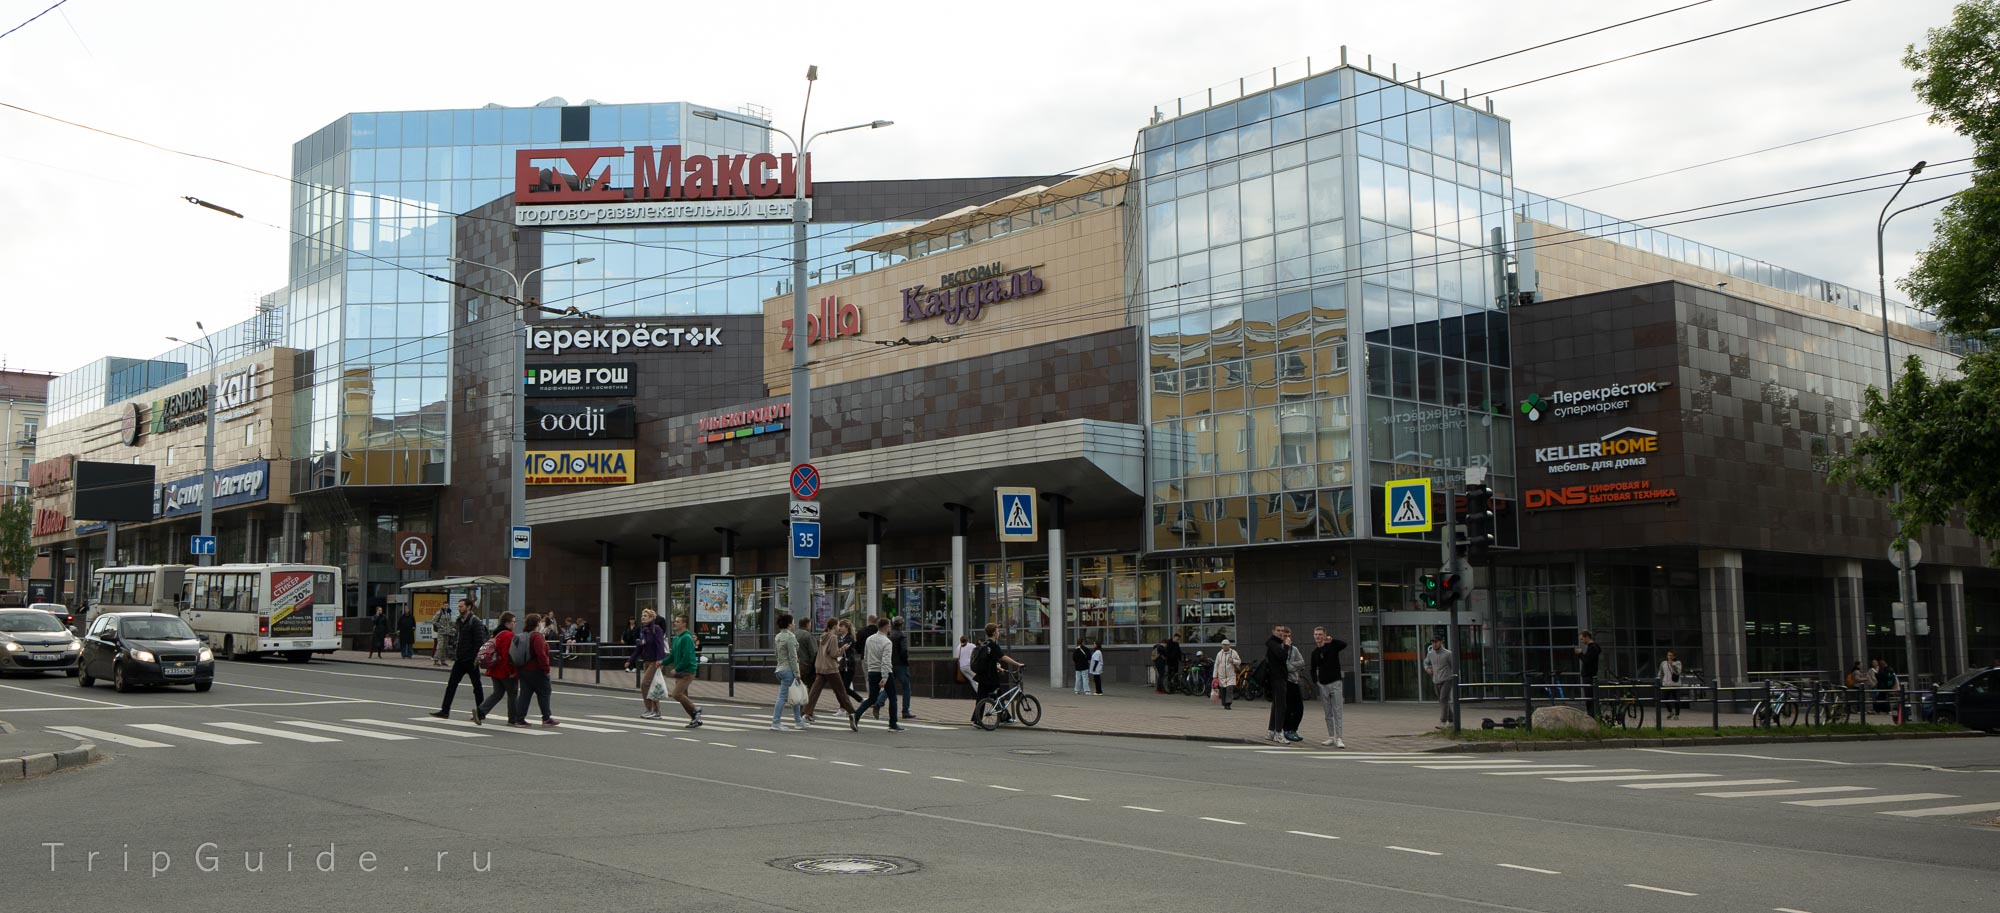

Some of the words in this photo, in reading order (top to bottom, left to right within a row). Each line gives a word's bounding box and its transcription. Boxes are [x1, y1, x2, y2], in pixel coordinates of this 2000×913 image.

[634, 145, 812, 198] Макси
[518, 201, 750, 222] торгово-развлекательный
[941, 261, 1001, 288] РЕСТОРАН
[216, 362, 257, 411] kari
[540, 368, 581, 385] РИВ
[586, 367, 628, 384] ГОШ
[164, 385, 206, 417] ZENDEN
[1553, 381, 1656, 404] Перекрёсток
[1554, 400, 1630, 418] супермаркет
[541, 407, 605, 436] oodji
[1535, 437, 1658, 462] KELLERHOME
[1549, 461, 1590, 473] мебель
[1592, 460, 1613, 471] для
[1615, 456, 1646, 469] дома
[1525, 485, 1587, 508] DNS
[1589, 481, 1640, 493] ЦИФРОВАЯ
[1642, 480, 1649, 489] И
[1589, 491, 1631, 504] БЫТОВАЯ
[1634, 489, 1675, 500] ТЕХНИКА
[799, 532, 814, 548] 35
[273, 576, 299, 597] СТИКЕР
[293, 588, 311, 602] 20%
